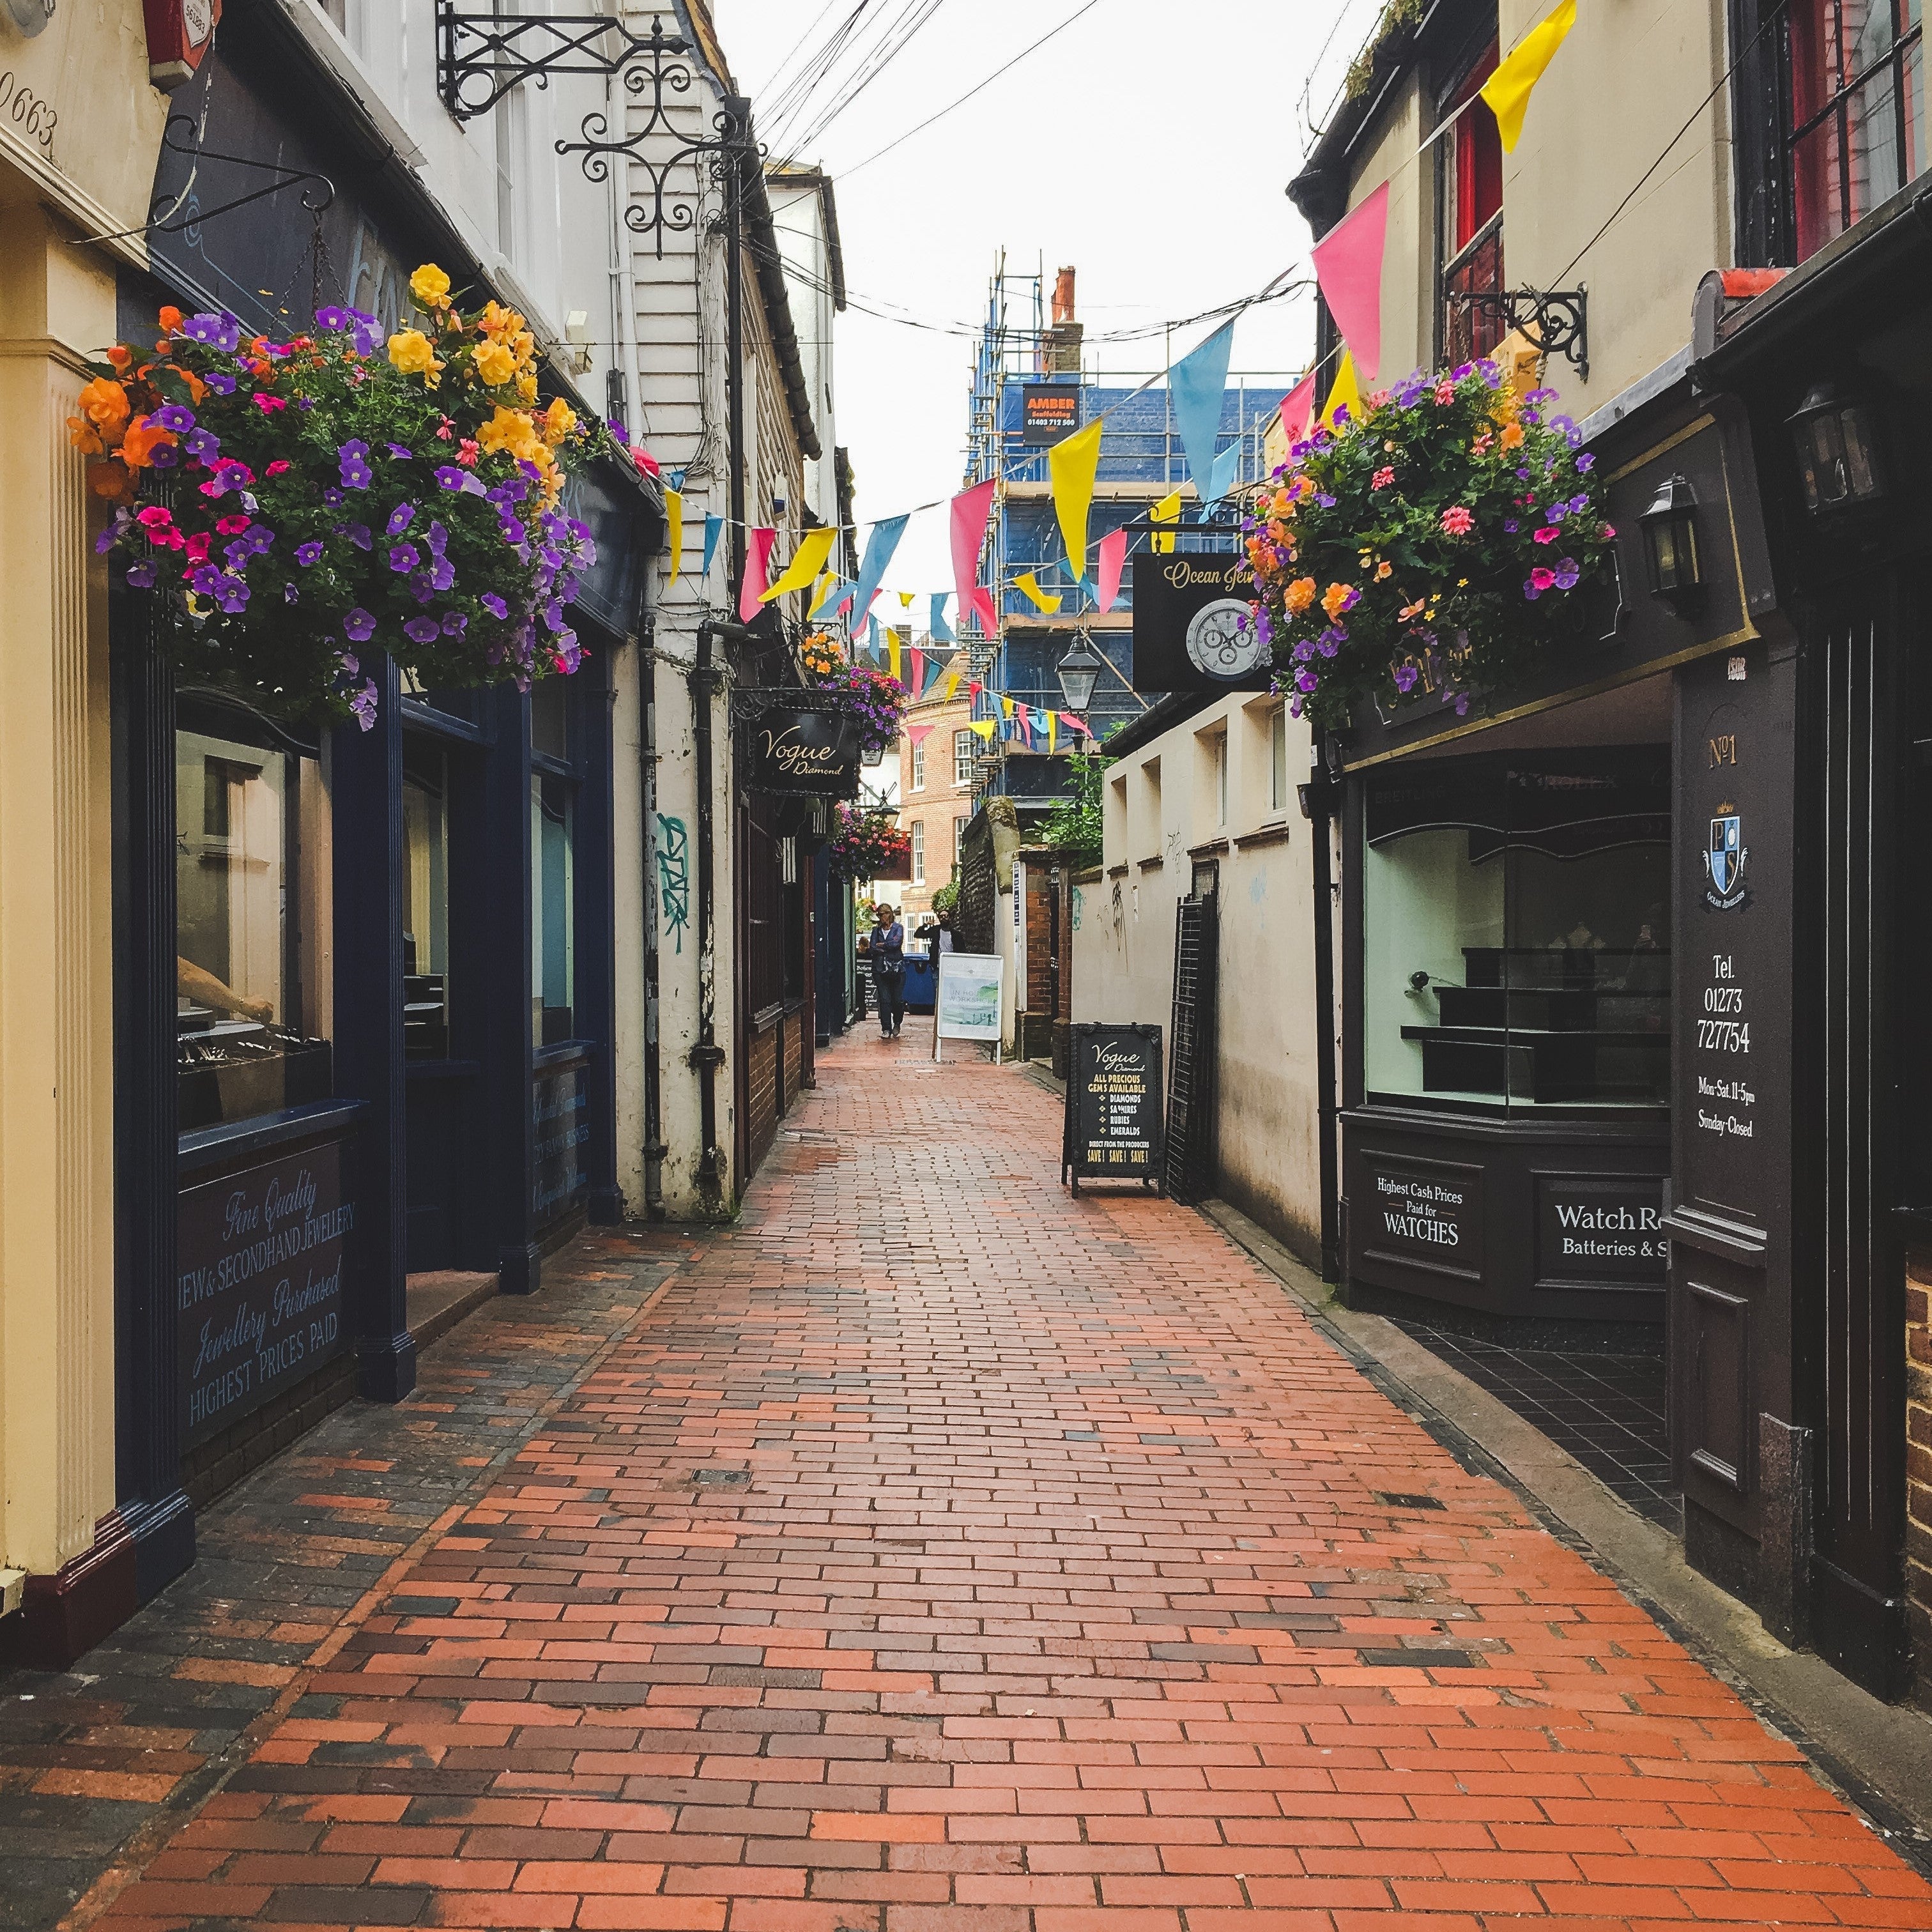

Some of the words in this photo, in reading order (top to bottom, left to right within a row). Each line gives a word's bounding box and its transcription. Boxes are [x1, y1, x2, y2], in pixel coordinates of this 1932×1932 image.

[0, 72, 57, 146] 0663
[1027, 398, 1075, 409] AMBER
[1163, 561, 1221, 589] Ocean
[758, 725, 836, 770] Vogue
[793, 762, 843, 775] Diamond
[1713, 822, 1724, 850] P
[1727, 852, 1735, 885] S
[1712, 954, 1735, 979] Tel.
[1704, 988, 1743, 1013] 01273
[1697, 1019, 1751, 1054] 727754
[1091, 1041, 1140, 1071] Vogue
[1114, 1063, 1146, 1072] Diamond
[1087, 1083, 1108, 1092] GEMS
[1108, 1084, 1146, 1093] AVAILABLE
[1094, 1074, 1107, 1083] ALL
[1108, 1075, 1140, 1084] PRECIOUS
[1110, 1094, 1141, 1103] DIAMONDS
[1110, 1116, 1130, 1124] RUBIES
[1110, 1126, 1140, 1136] EMERALDS
[1377, 1177, 1409, 1195] Highest
[1411, 1183, 1433, 1199] Cash
[1434, 1186, 1462, 1204] Prices
[223, 1190, 259, 1241] Fine
[265, 1169, 317, 1233] Quality
[1406, 1200, 1423, 1215] Paid
[1425, 1204, 1437, 1217] for
[1554, 1205, 1636, 1230] Watch
[1383, 1212, 1459, 1246] WATCHES
[206, 1270, 216, 1298] &
[217, 1227, 300, 1292] SECONDHAND
[301, 1202, 356, 1252] JEWELLERY
[1563, 1238, 1636, 1256] Batteries
[1641, 1241, 1653, 1257] &
[193, 1301, 266, 1380] Jewellery
[273, 1254, 342, 1327] Purchased
[189, 1360, 254, 1427] HIGHEST
[259, 1330, 304, 1384] PRICES
[309, 1312, 339, 1353] PAID
